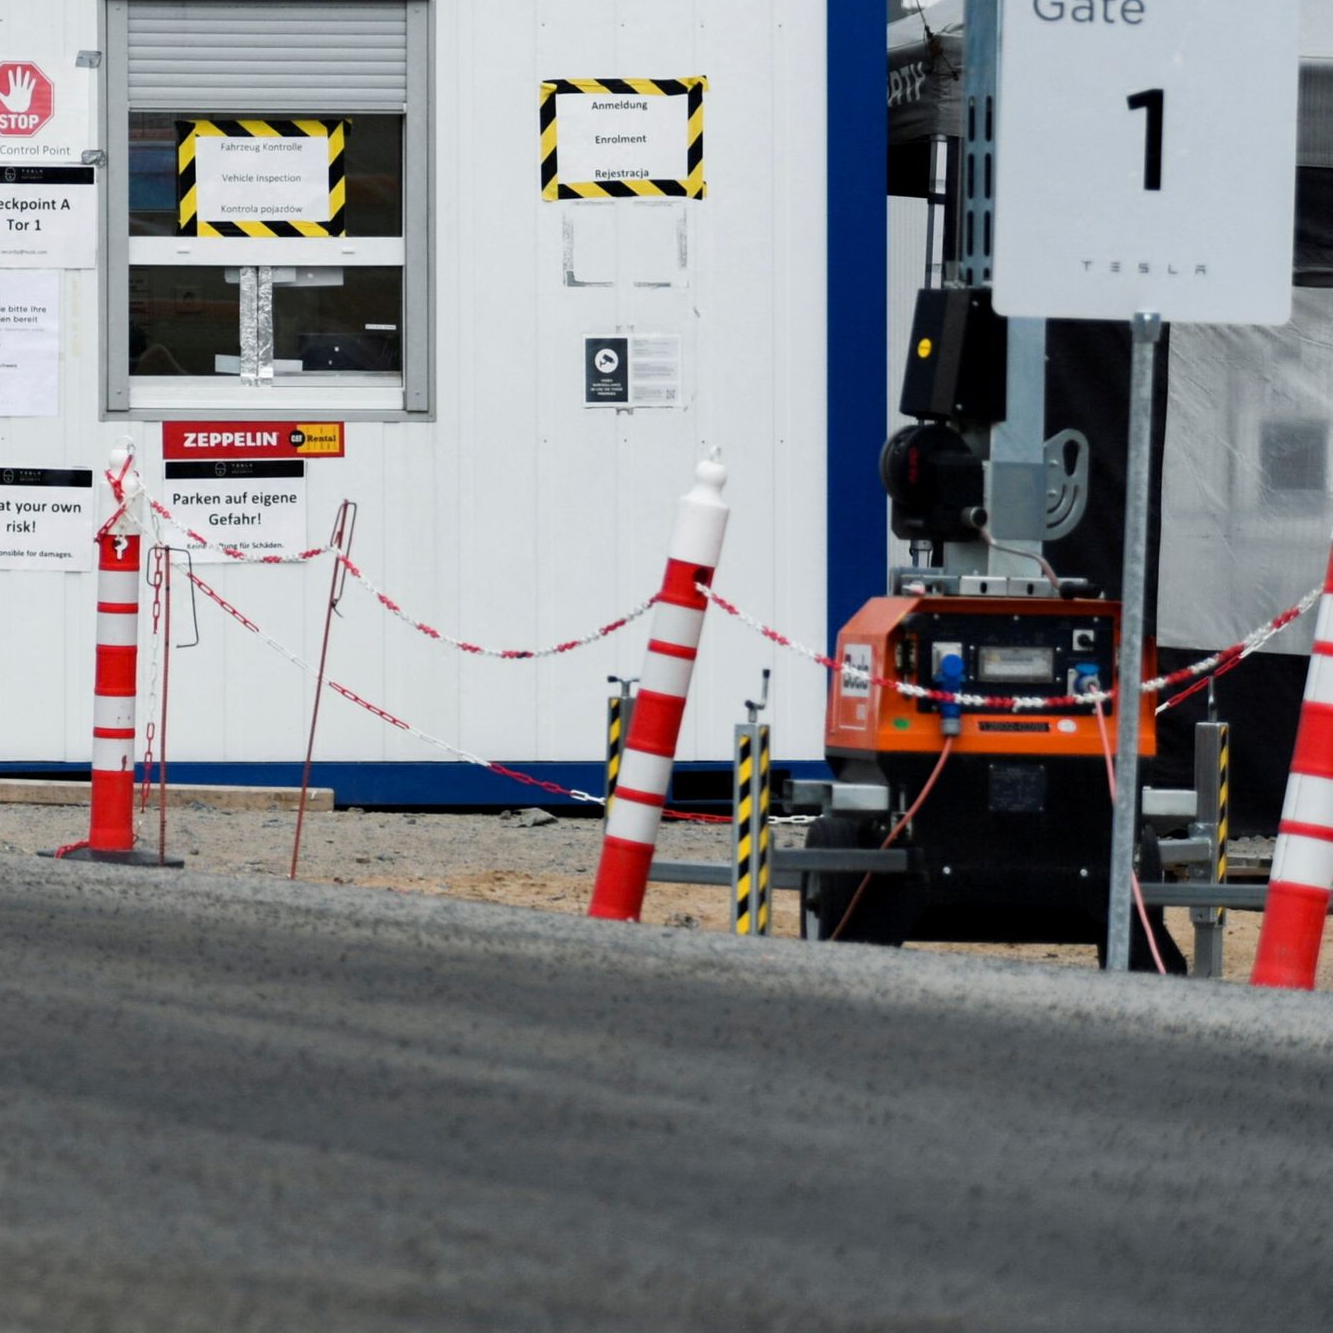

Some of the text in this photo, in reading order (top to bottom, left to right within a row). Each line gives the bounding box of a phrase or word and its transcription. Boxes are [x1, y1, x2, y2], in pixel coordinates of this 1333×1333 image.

[591, 101, 648, 111] Anmeldung
[595, 135, 647, 144] Enrolment
[1126, 89, 1164, 191] 1
[0, 145, 39, 155] Control
[43, 145, 71, 156] Point
[221, 143, 303, 153] Fahrzeug Kontrolle
[222, 174, 301, 184] Vehicle Inspection
[595, 169, 649, 179] Rejestracja
[60, 199, 71, 210] A
[221, 205, 303, 216] Kontrola pojazdów
[6, 219, 42, 231] Tor 1
[1082, 261, 1207, 275] TESLA
[8, 305, 28, 313] bitte
[183, 432, 278, 447] ZEPPELIN
[307, 434, 336, 443] Rental
[173, 492, 297, 507] Parken auf eigene
[15, 502, 47, 514] your
[51, 503, 81, 513] own
[209, 513, 262, 525] Gefahr!
[6, 521, 36, 533] risk!
[39, 550, 73, 559] damages.
